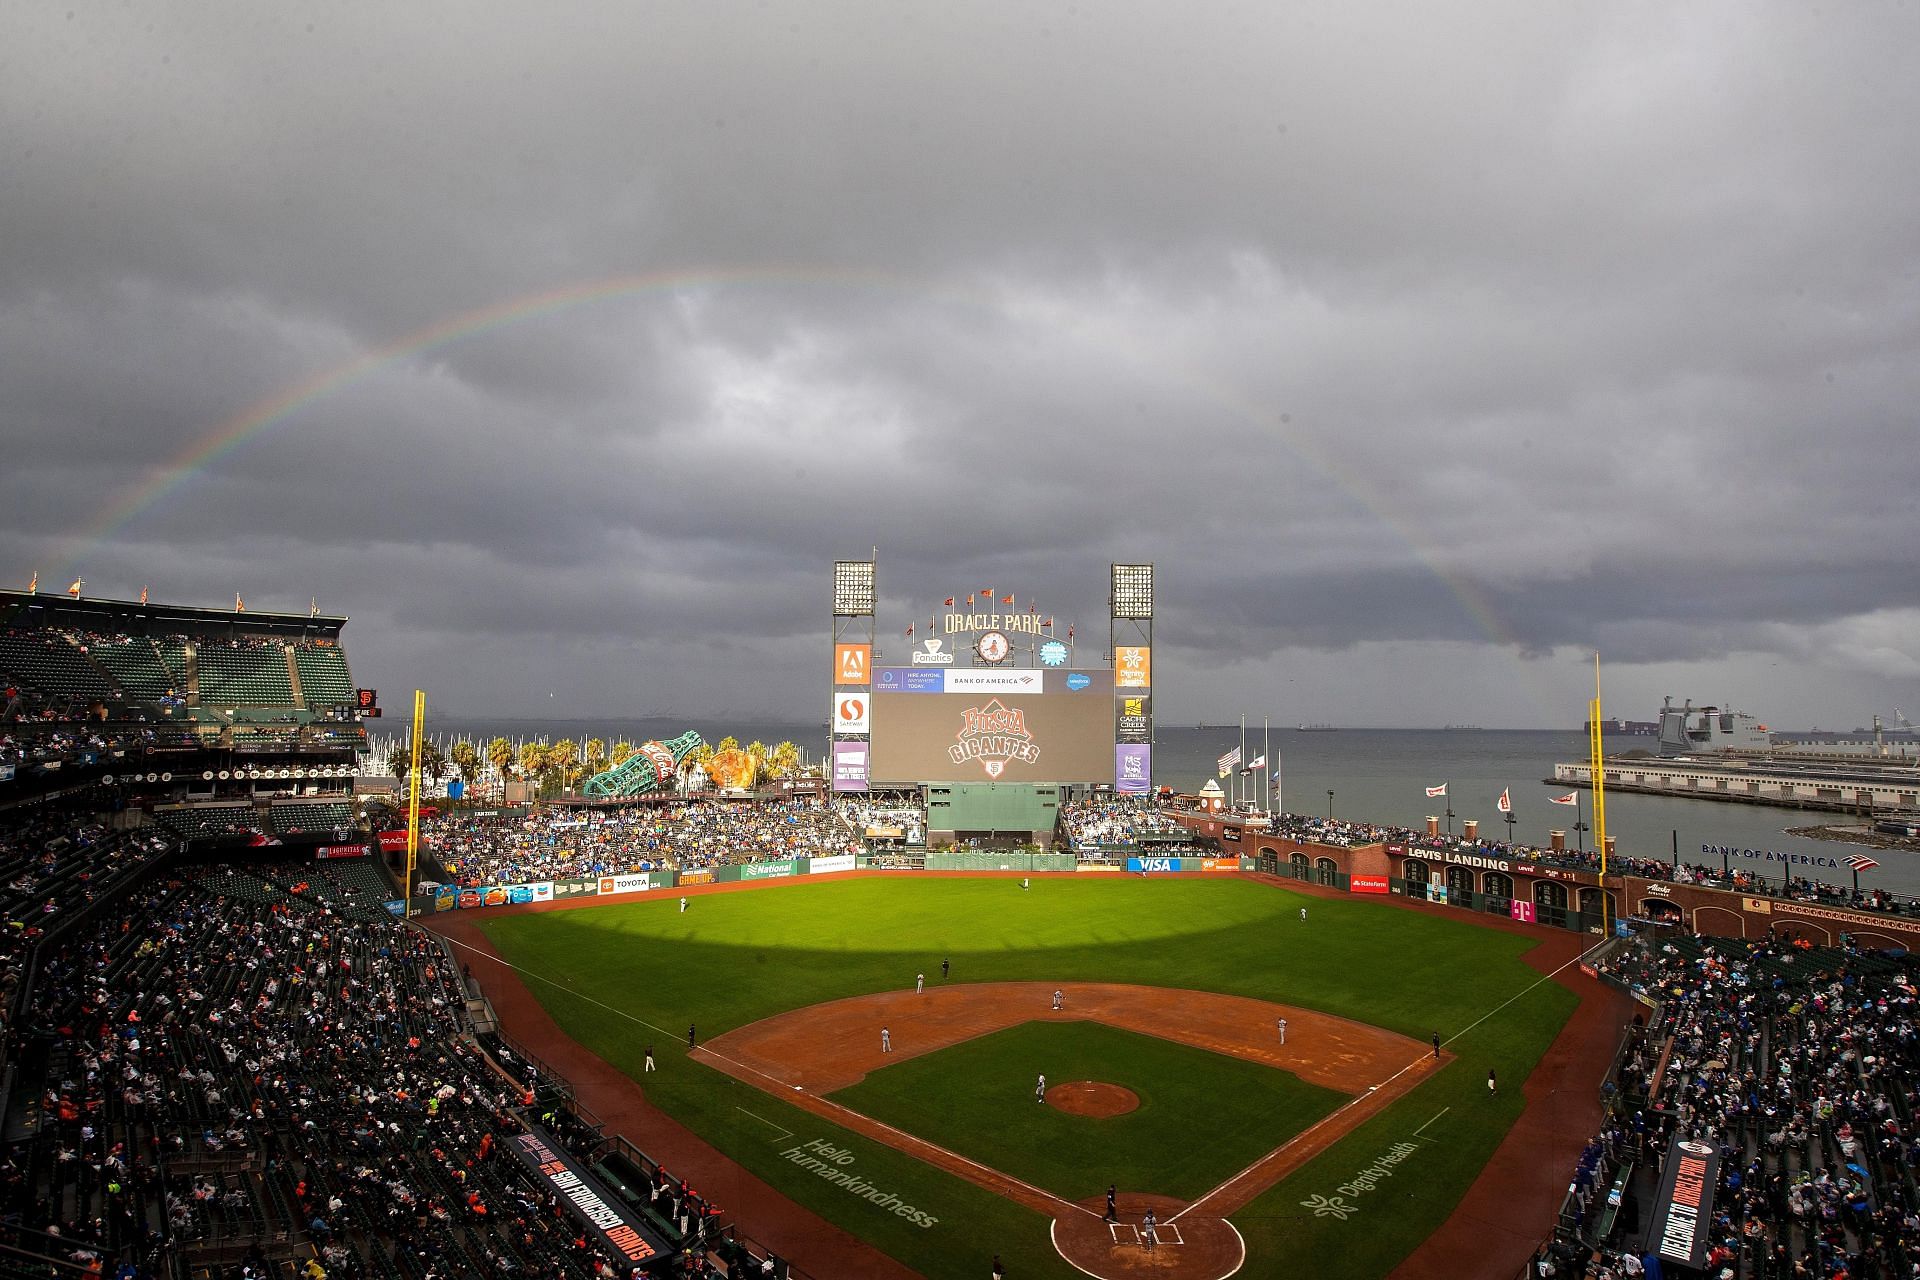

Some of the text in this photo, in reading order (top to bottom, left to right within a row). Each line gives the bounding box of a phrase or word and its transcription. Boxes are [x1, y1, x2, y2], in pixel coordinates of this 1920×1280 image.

[945, 613, 1042, 635] ORACLE PARK
[914, 652, 952, 663] Fanatics
[1120, 670, 1145, 679] Dignity
[361, 691, 372, 706] SF
[960, 707, 1028, 738] FIESTA
[948, 736, 1041, 764] GIGANTES
[990, 762, 1000, 774] SF
[329, 846, 360, 855] LAGUNITAS
[1702, 844, 1839, 868] BANK OF AMERICA
[757, 862, 792, 874] National
[1138, 859, 1171, 871] VISA
[1446, 853, 1509, 871] LANDING
[616, 879, 647, 887] TOYOTA
[679, 873, 713, 886] GAME UP
[1647, 883, 1671, 894] Alaska
[1590, 926, 1603, 935] 309
[803, 1138, 855, 1165] Hello
[1336, 1142, 1419, 1198] Dignity Health
[1678, 1156, 1707, 1178] PARK
[778, 1146, 939, 1229] humankindness
[1672, 1173, 1704, 1207] ORACLE
[549, 1170, 624, 1230] SAN FRANCISCO
[1660, 1203, 1698, 1261] WELCOME TO
[605, 1225, 656, 1261] GIANTS
